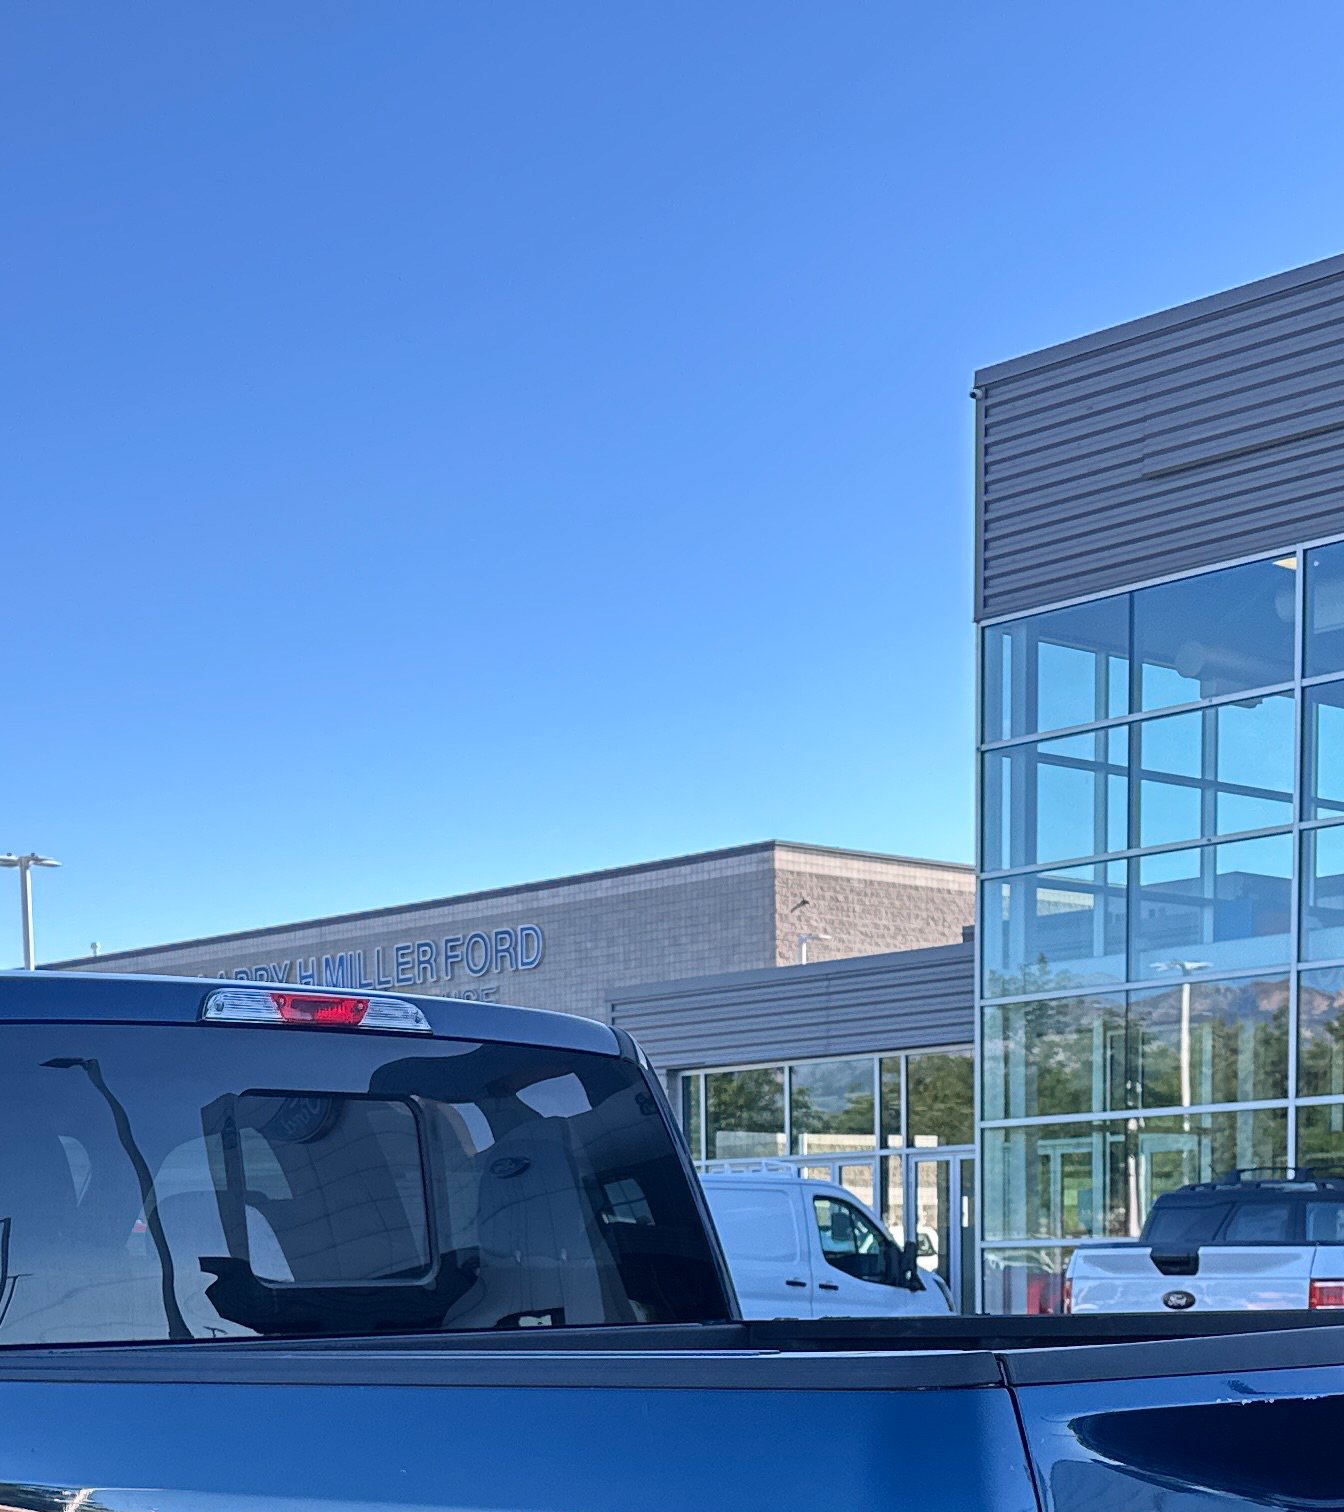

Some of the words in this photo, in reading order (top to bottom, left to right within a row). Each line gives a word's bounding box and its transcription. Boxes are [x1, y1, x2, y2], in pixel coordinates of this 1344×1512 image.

[296, 956, 317, 985] H
[322, 939, 437, 990] MILLER
[444, 922, 543, 981] FORD
